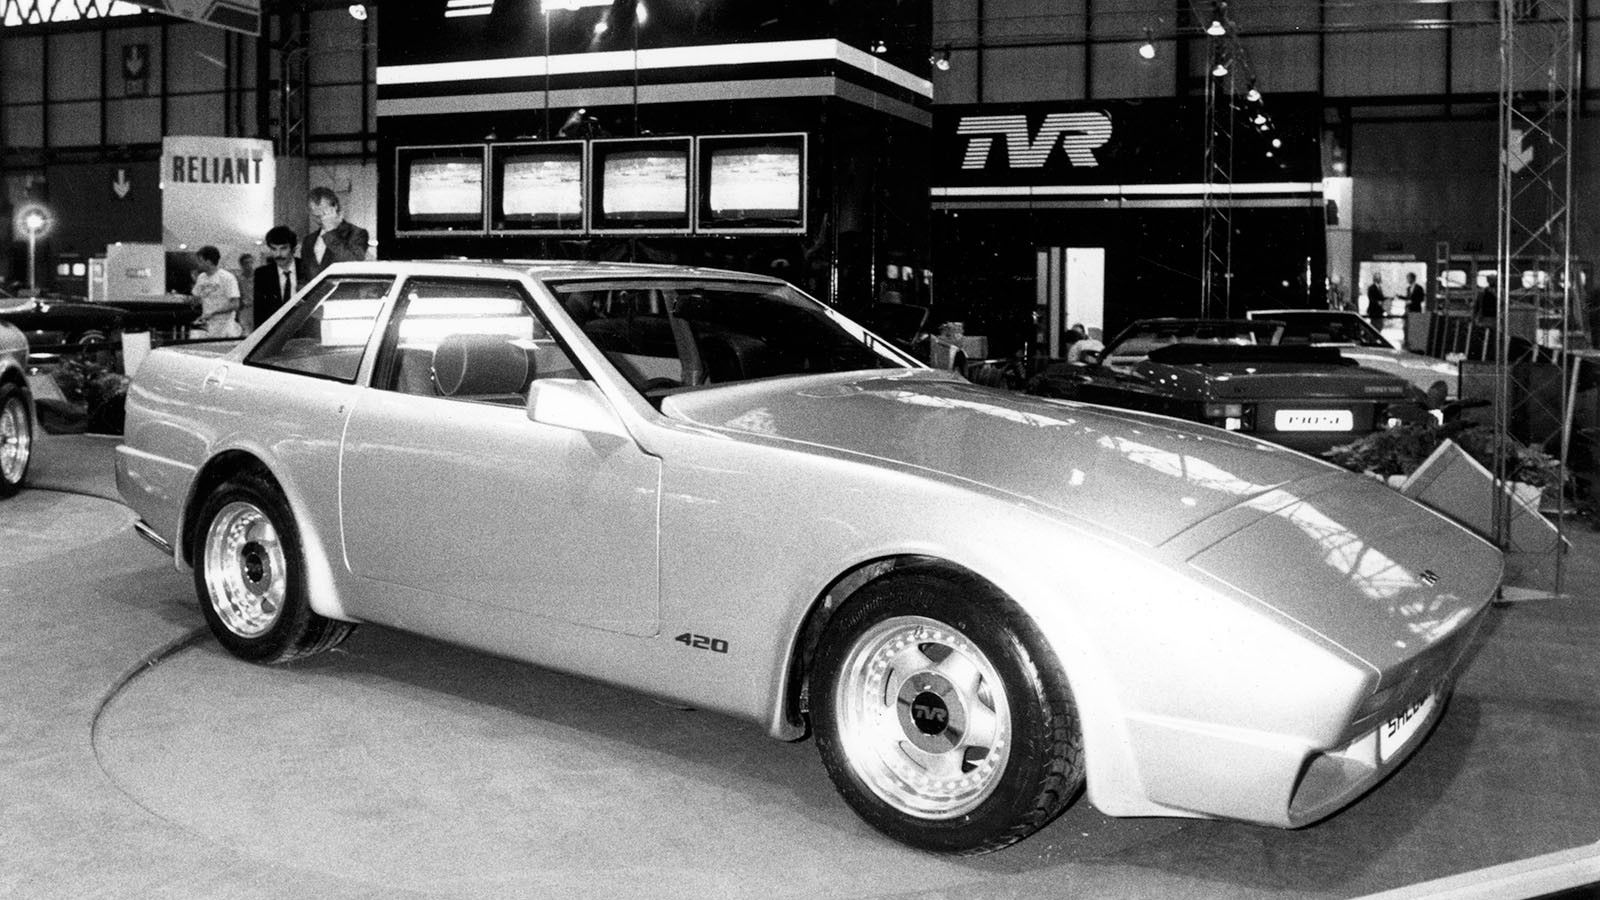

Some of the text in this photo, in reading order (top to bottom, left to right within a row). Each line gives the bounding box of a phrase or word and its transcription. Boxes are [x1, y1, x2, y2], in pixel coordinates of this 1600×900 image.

[957, 112, 1112, 169] TVR
[173, 155, 263, 184] RELIANT
[675, 633, 728, 654] 420
[914, 704, 947, 722] TVR
